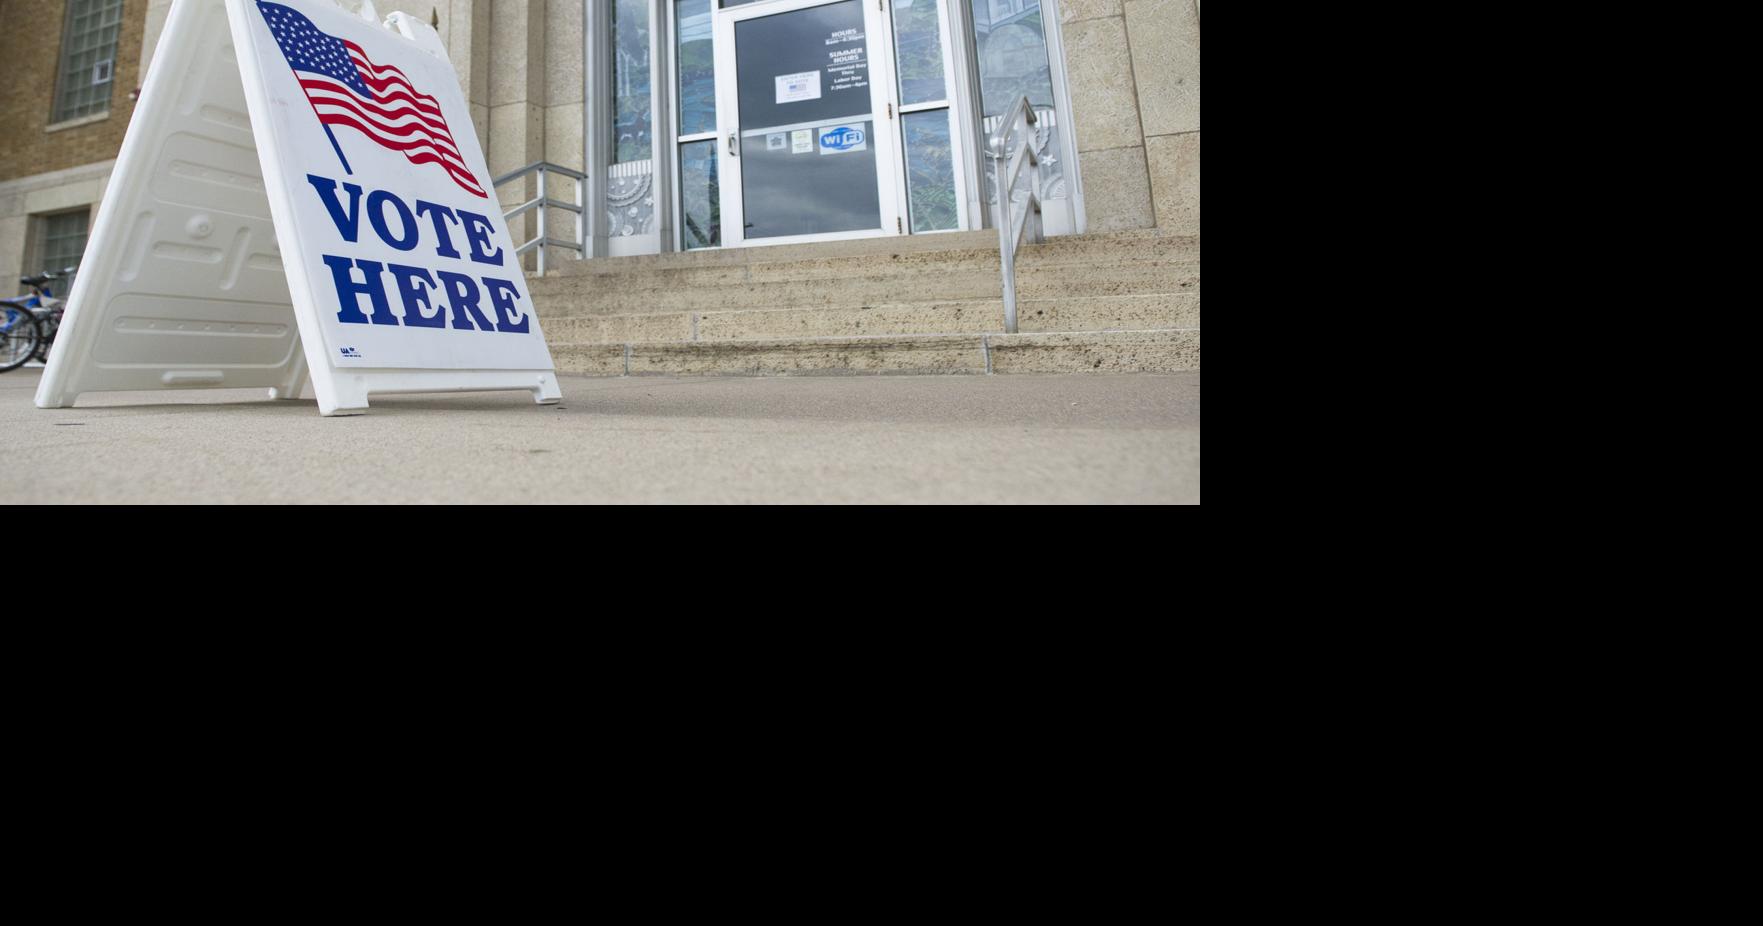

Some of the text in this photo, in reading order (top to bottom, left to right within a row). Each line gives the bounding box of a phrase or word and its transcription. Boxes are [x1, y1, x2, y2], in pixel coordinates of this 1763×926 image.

[832, 28, 857, 38] HOURS
[829, 47, 863, 58] SUMMER
[833, 55, 859, 63] HOURS
[306, 173, 504, 267] VOTE
[322, 254, 530, 334] HERE
